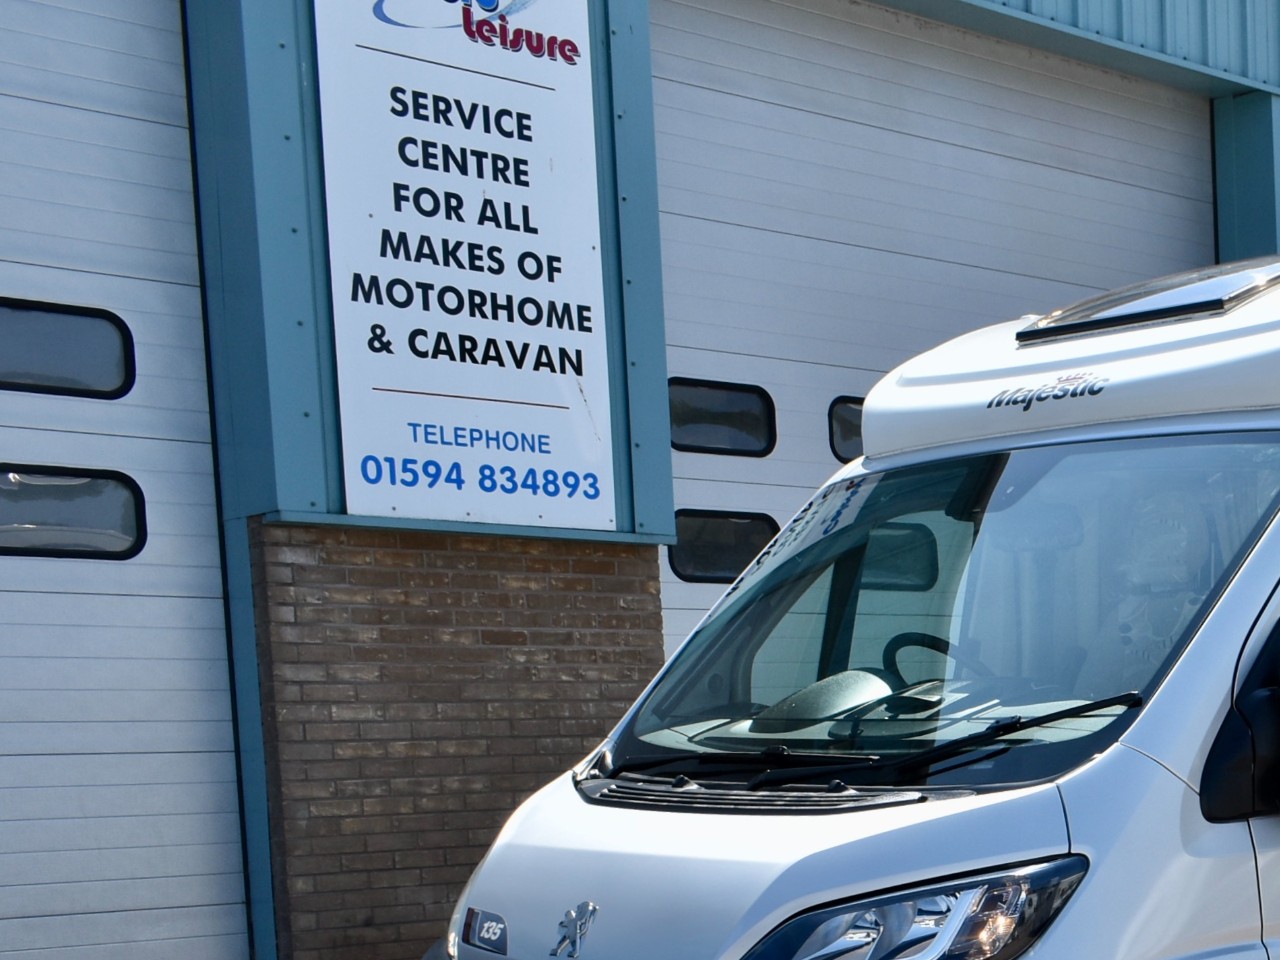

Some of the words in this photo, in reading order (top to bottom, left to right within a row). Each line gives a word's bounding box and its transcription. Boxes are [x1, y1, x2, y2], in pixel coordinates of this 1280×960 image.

[389, 86, 533, 143] SERVICE
[397, 136, 531, 188] CENTRE
[392, 182, 466, 223] FOR
[477, 198, 539, 235] ALL
[379, 228, 505, 276] MAKES
[517, 251, 563, 283] OF
[350, 272, 594, 334] MOTORHOME
[367, 323, 395, 355] &
[407, 328, 584, 377] CARAVAN
[986, 376, 1110, 412] Majestic
[407, 422, 552, 455] TELEPHONE
[360, 454, 466, 491] 01594
[478, 463, 601, 501] 834893
[480, 920, 505, 941] 135
